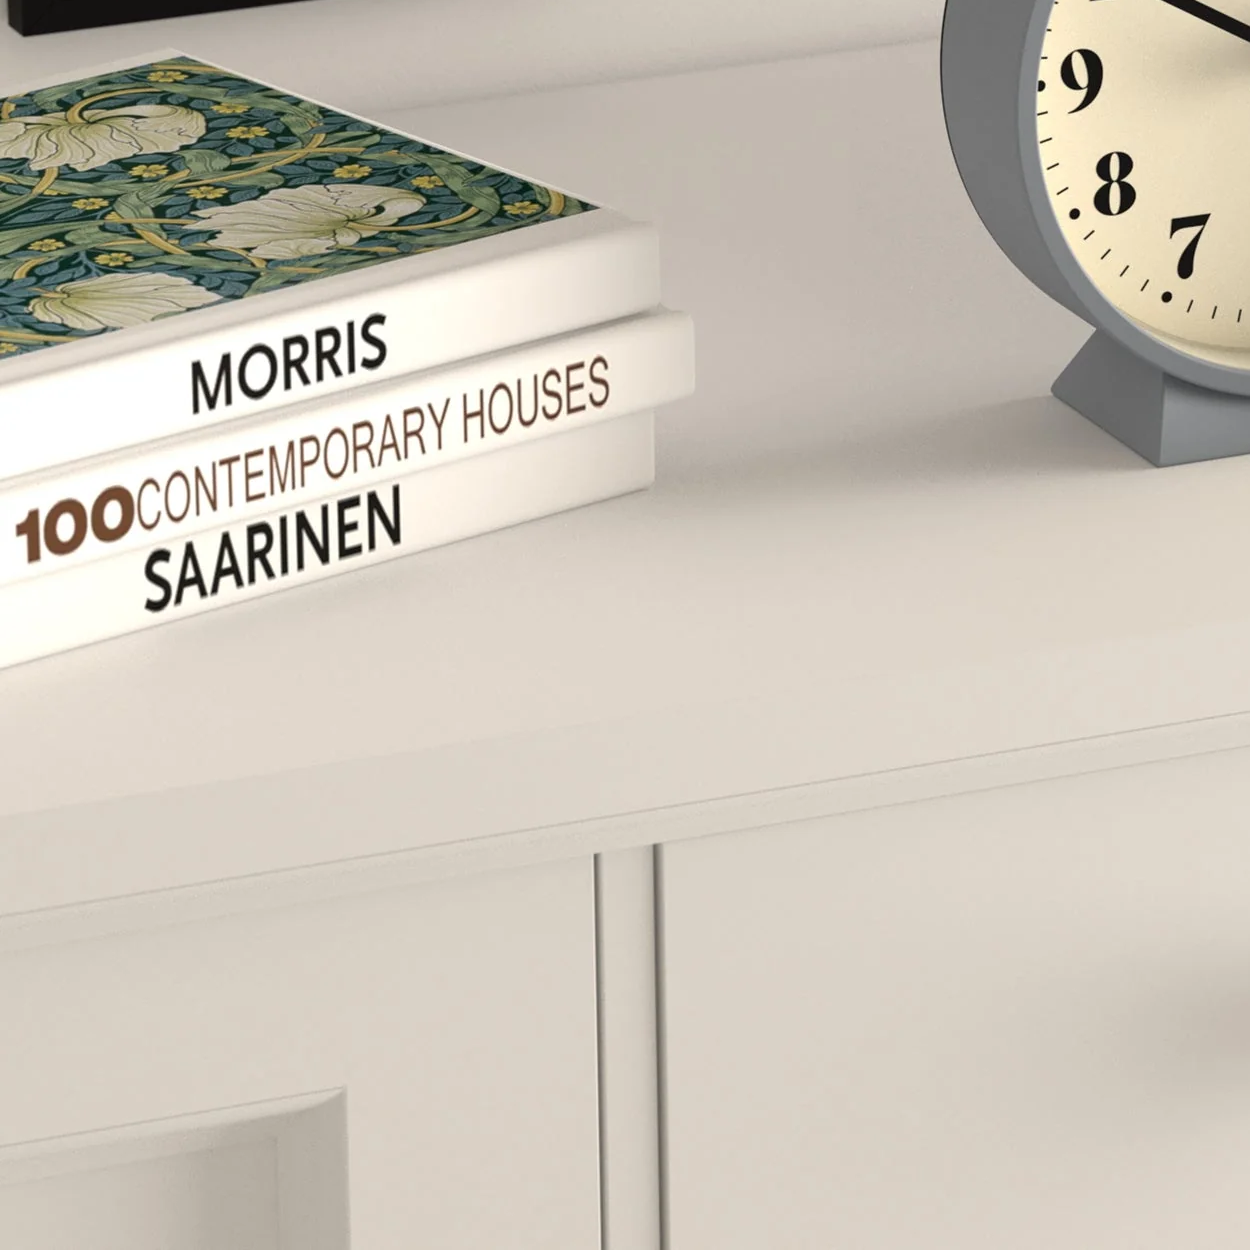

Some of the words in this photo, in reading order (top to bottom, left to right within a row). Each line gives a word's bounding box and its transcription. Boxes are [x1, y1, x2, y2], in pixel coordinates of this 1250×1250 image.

[1060, 48, 1104, 114] 9
[1093, 151, 1137, 216] 8
[1169, 213, 1211, 280] 7
[191, 312, 388, 415] MORRIS
[463, 356, 610, 443] HOUSES
[143, 483, 402, 613] SAARINEN
